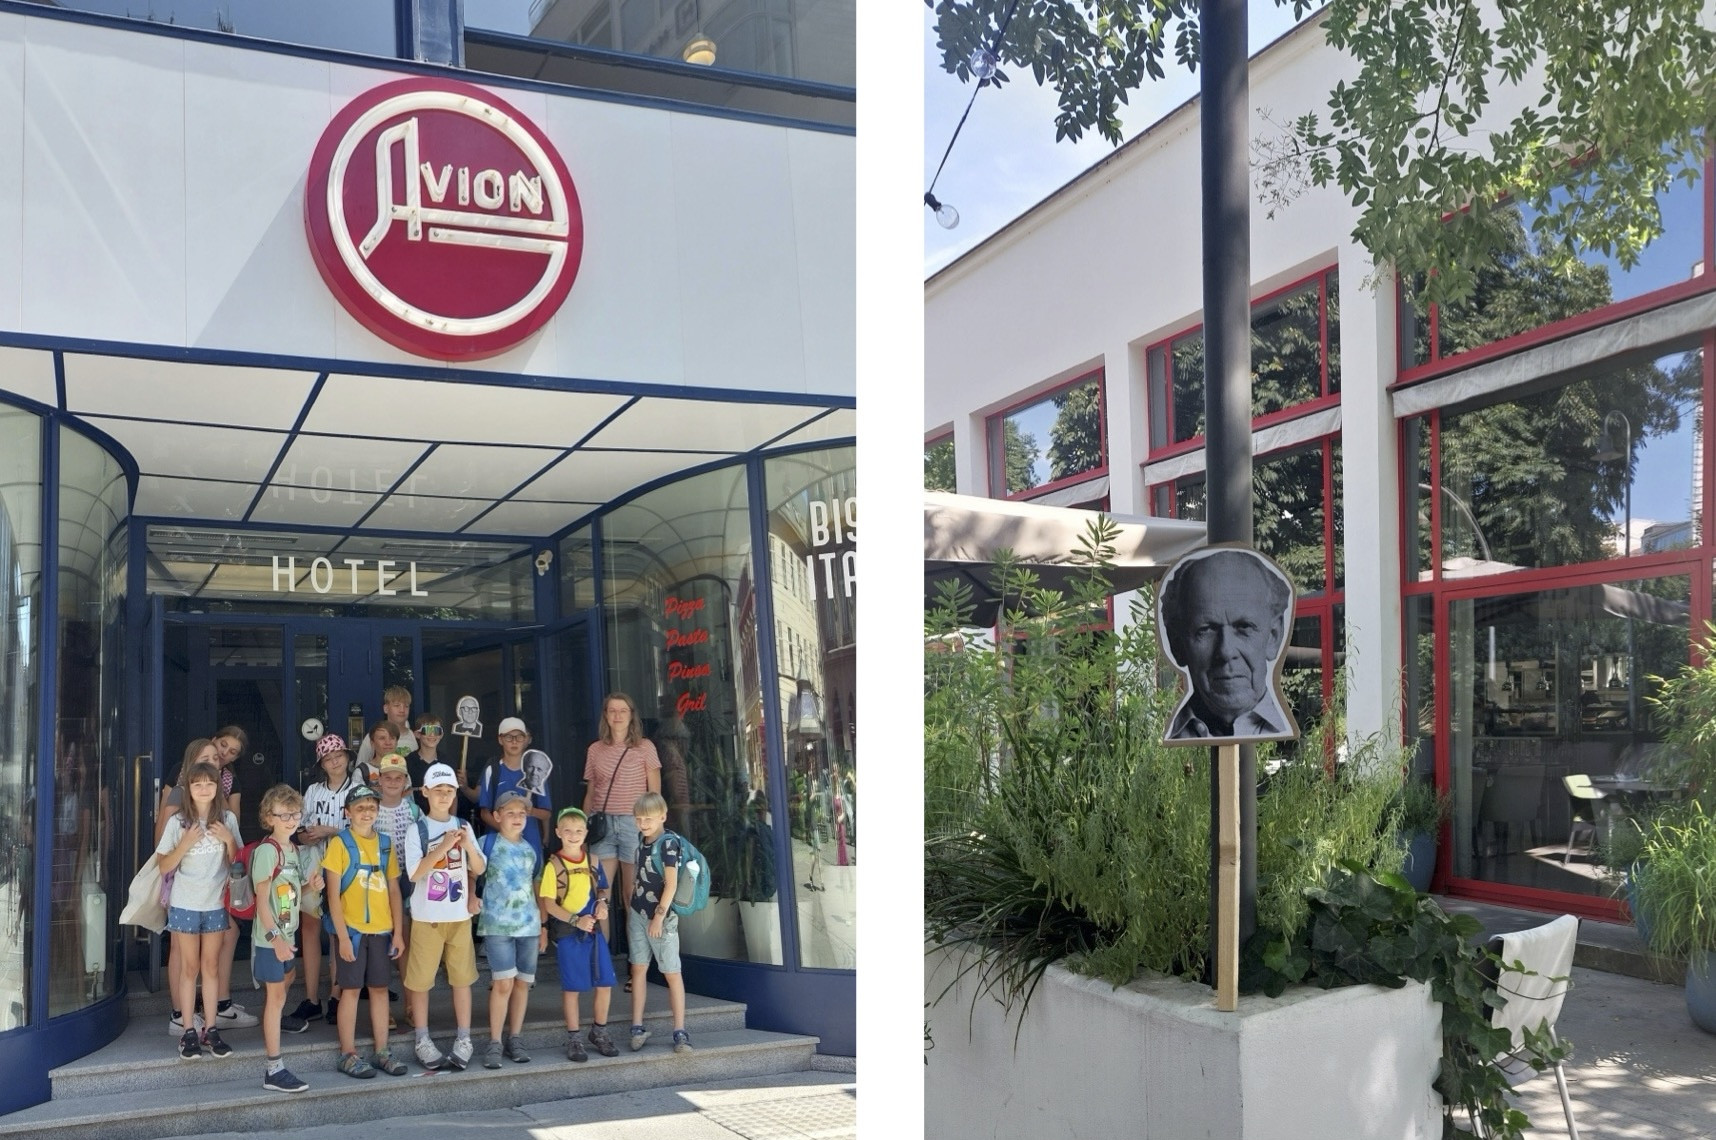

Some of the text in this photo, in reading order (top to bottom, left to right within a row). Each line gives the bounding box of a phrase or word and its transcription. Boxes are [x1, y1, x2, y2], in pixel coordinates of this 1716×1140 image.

[359, 116, 544, 260] AVION
[809, 497, 856, 547] BIS
[272, 555, 429, 597] HOTEL
[806, 550, 856, 600] ITA
[664, 596, 705, 620] Pizza
[665, 628, 709, 651] Pasta
